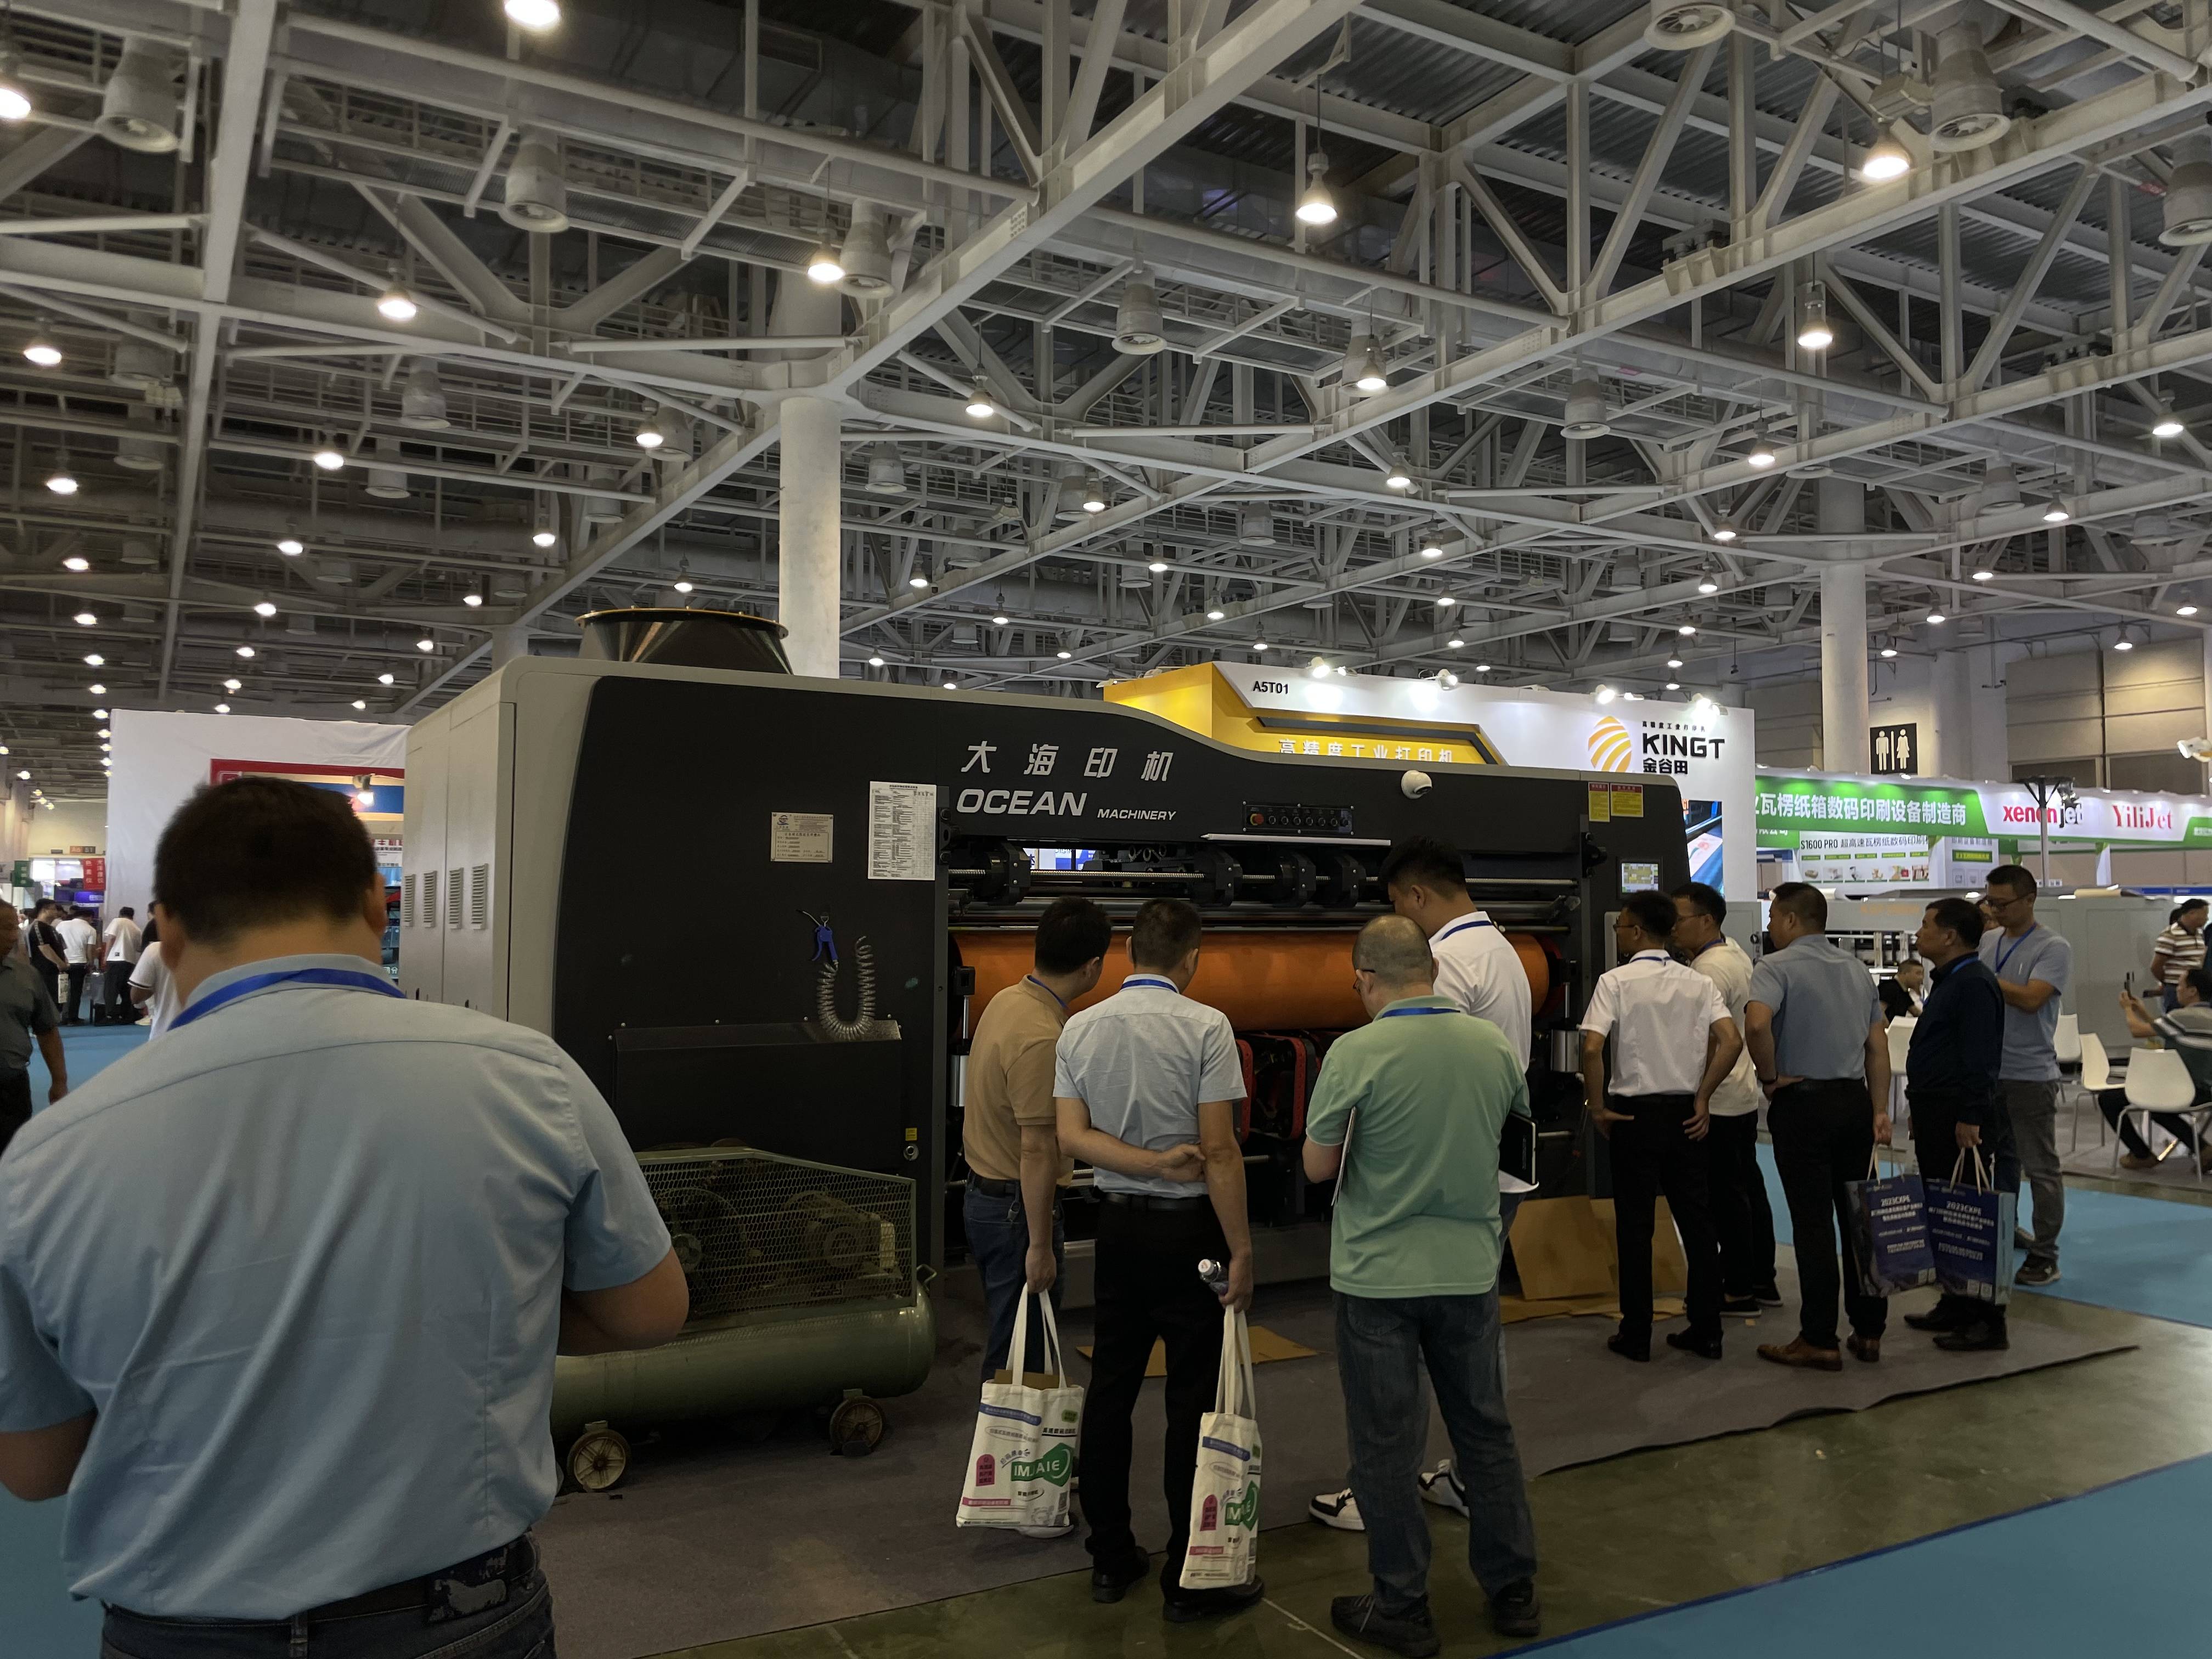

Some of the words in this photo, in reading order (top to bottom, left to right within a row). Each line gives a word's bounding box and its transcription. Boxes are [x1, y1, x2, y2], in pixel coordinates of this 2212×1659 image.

[1253, 681, 1289, 695] A5T01
[1279, 739, 1453, 763] 高精度工业打印机
[1643, 733, 1725, 760] KINGT
[961, 741, 1173, 781] 大海印机
[1643, 758, 1688, 774] 金谷田
[956, 788, 1087, 816] OCEAN
[1097, 809, 1176, 820] MACHINERY
[1756, 792, 1966, 826] 瓦楞纸箱数码印刷设备制造商
[2112, 805, 2173, 830] YiliJet
[1801, 840, 1822, 850] S1600
[1824, 839, 1838, 848] PRO
[1841, 836, 1928, 848] 超高速瓦楞纸数码印刷
